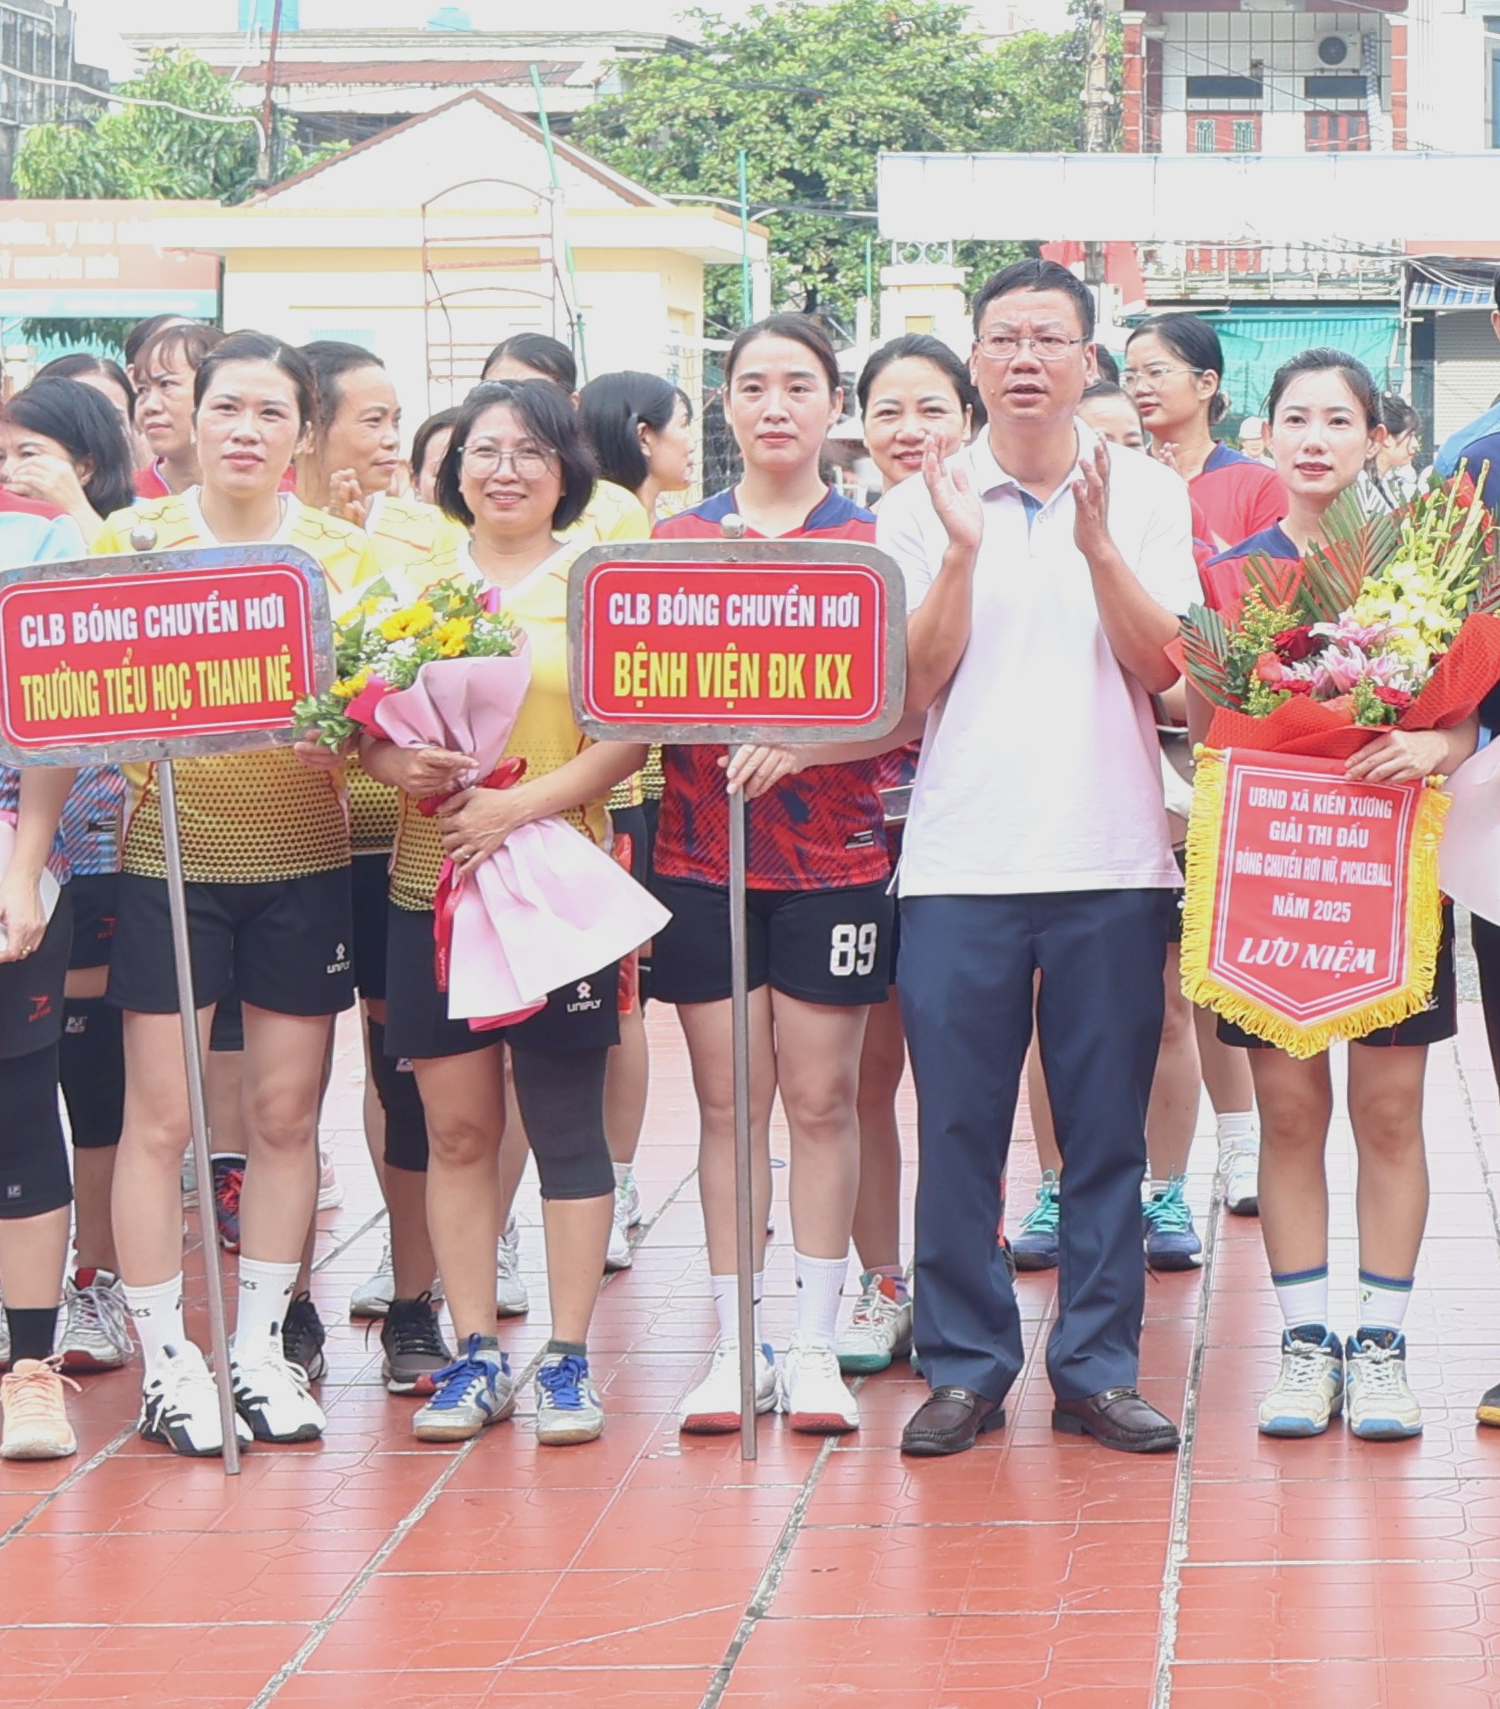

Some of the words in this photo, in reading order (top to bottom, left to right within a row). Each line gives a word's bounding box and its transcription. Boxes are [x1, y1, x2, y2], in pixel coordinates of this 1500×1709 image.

[20, 613, 66, 649] CLB
[72, 603, 138, 644] BÓNG
[244, 593, 285, 630] HƠI
[609, 593, 651, 625] CLB
[657, 587, 720, 626] BÓNG
[822, 592, 860, 628] HƠI
[20, 660, 100, 722] TRƯỜNG
[103, 647, 147, 715] TIỂU
[152, 662, 192, 720] HỌC
[196, 657, 262, 707] THANH
[265, 644, 294, 703] NÊ
[614, 641, 688, 708] BỆNH
[697, 642, 760, 708] VIỆN
[768, 653, 806, 699] ĐK
[814, 654, 852, 699] KX
[1249, 786, 1288, 810] UBND
[1290, 788, 1311, 813] XÃ
[1312, 789, 1346, 816] KIẾN
[1348, 795, 1393, 819] XƯƠNG
[1269, 816, 1302, 843] GIẢI
[1307, 825, 1332, 846] THI
[1336, 820, 1370, 848] ĐẤU
[1235, 846, 1262, 875] BÓNG
[1340, 860, 1393, 887] PICKLEBALL
[1272, 894, 1309, 919] NĂM
[1312, 899, 1351, 923] 2025
[830, 923, 877, 976] 89
[1238, 936, 1299, 968] LƯU
[1301, 940, 1376, 979] NIỆM
[567, 998, 602, 1013] UNIFLY
